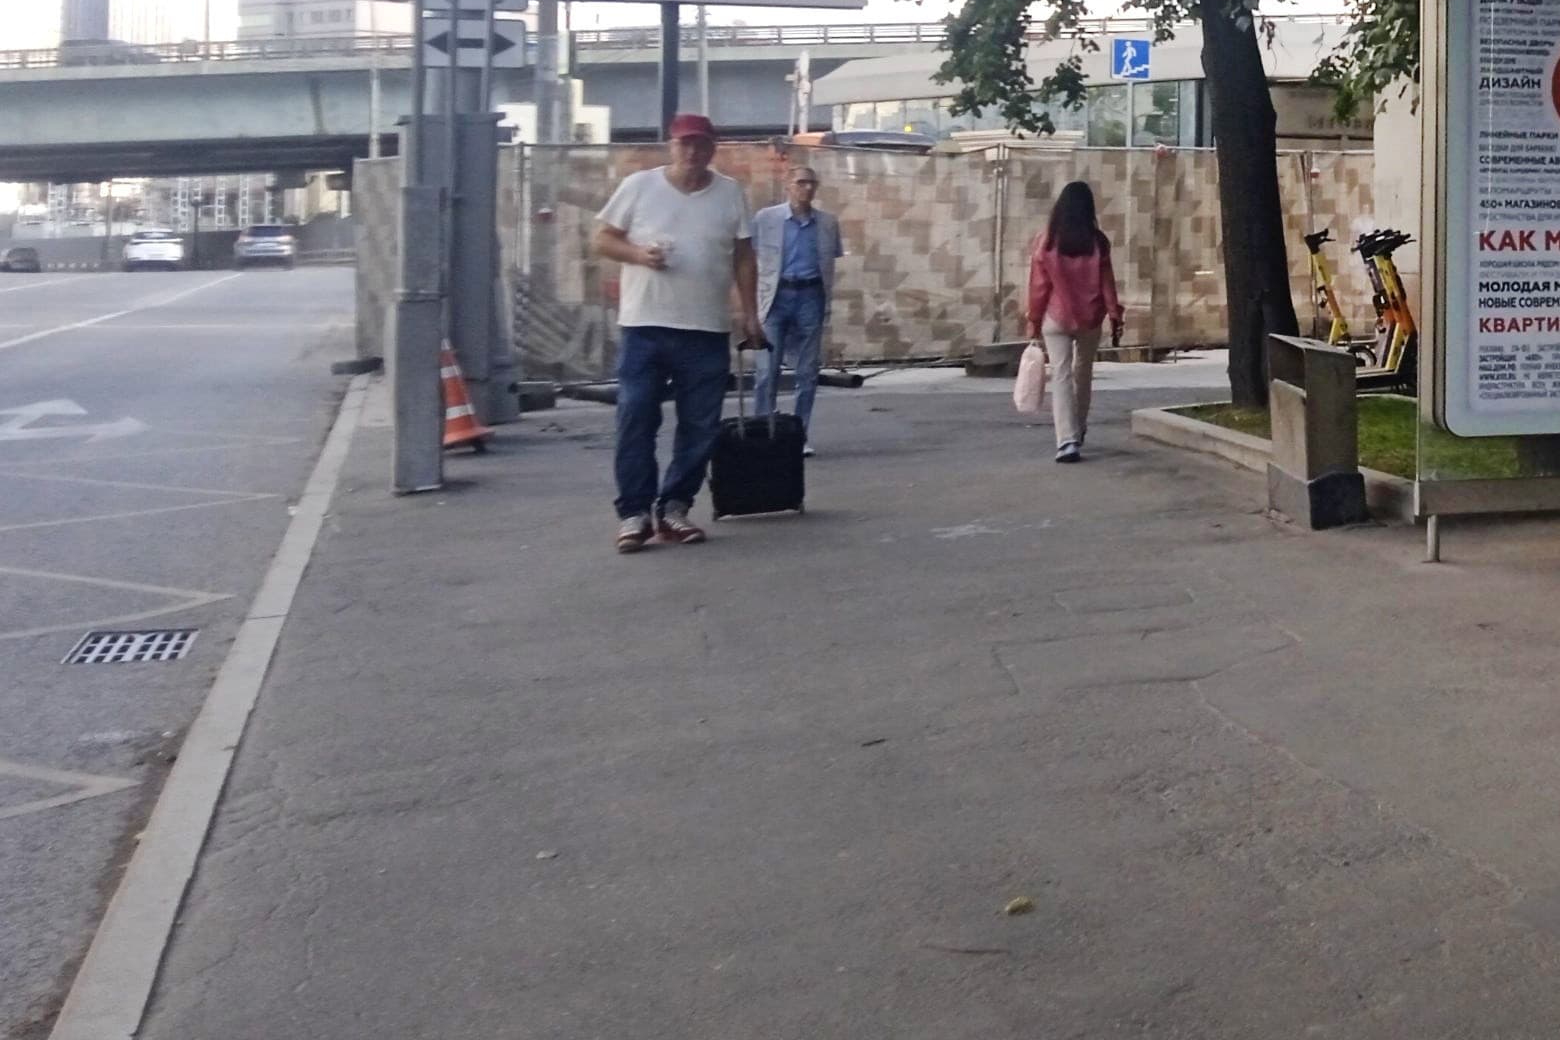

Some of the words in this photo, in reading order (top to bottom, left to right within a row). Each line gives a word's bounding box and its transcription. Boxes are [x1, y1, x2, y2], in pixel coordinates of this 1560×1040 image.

[1479, 75, 1542, 90] ДИЗАЙН
[1529, 131, 1559, 140] ПАРКИ
[1479, 230, 1537, 251] КАК
[1478, 281, 1551, 293] МОЛОДАЯ
[1478, 297, 1517, 308] НОВЫЕ
